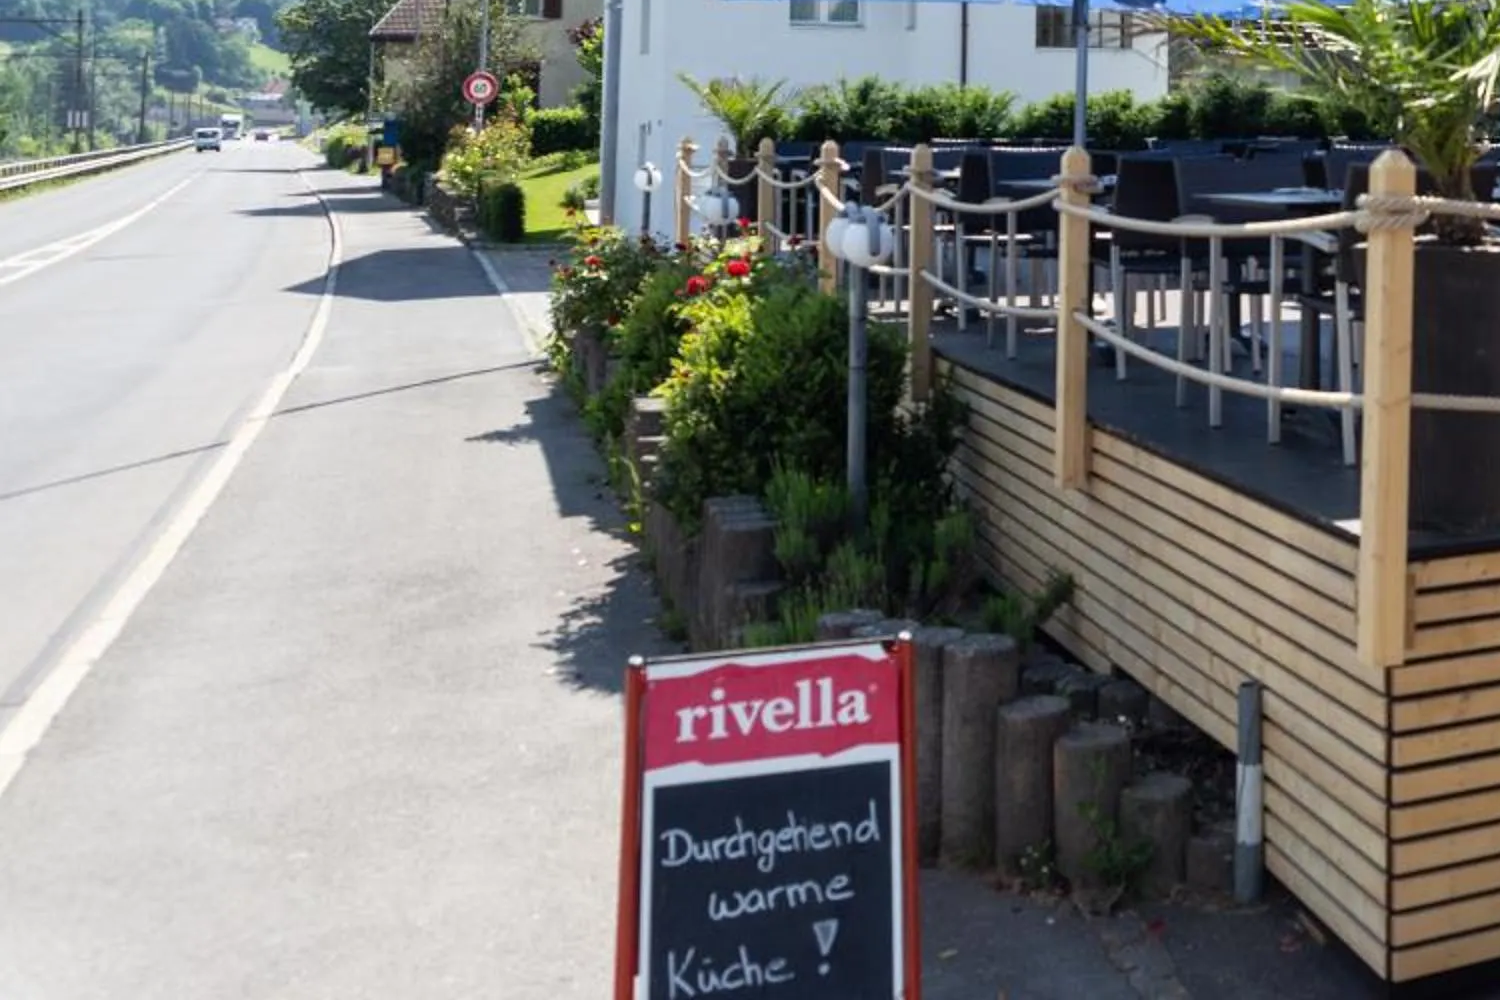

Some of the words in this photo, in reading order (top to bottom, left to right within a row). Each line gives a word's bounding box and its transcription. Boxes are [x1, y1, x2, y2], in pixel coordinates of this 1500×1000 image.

[676, 677, 870, 743] rivella
[660, 798, 880, 873] Durchgehend
[708, 874, 855, 920] warme
